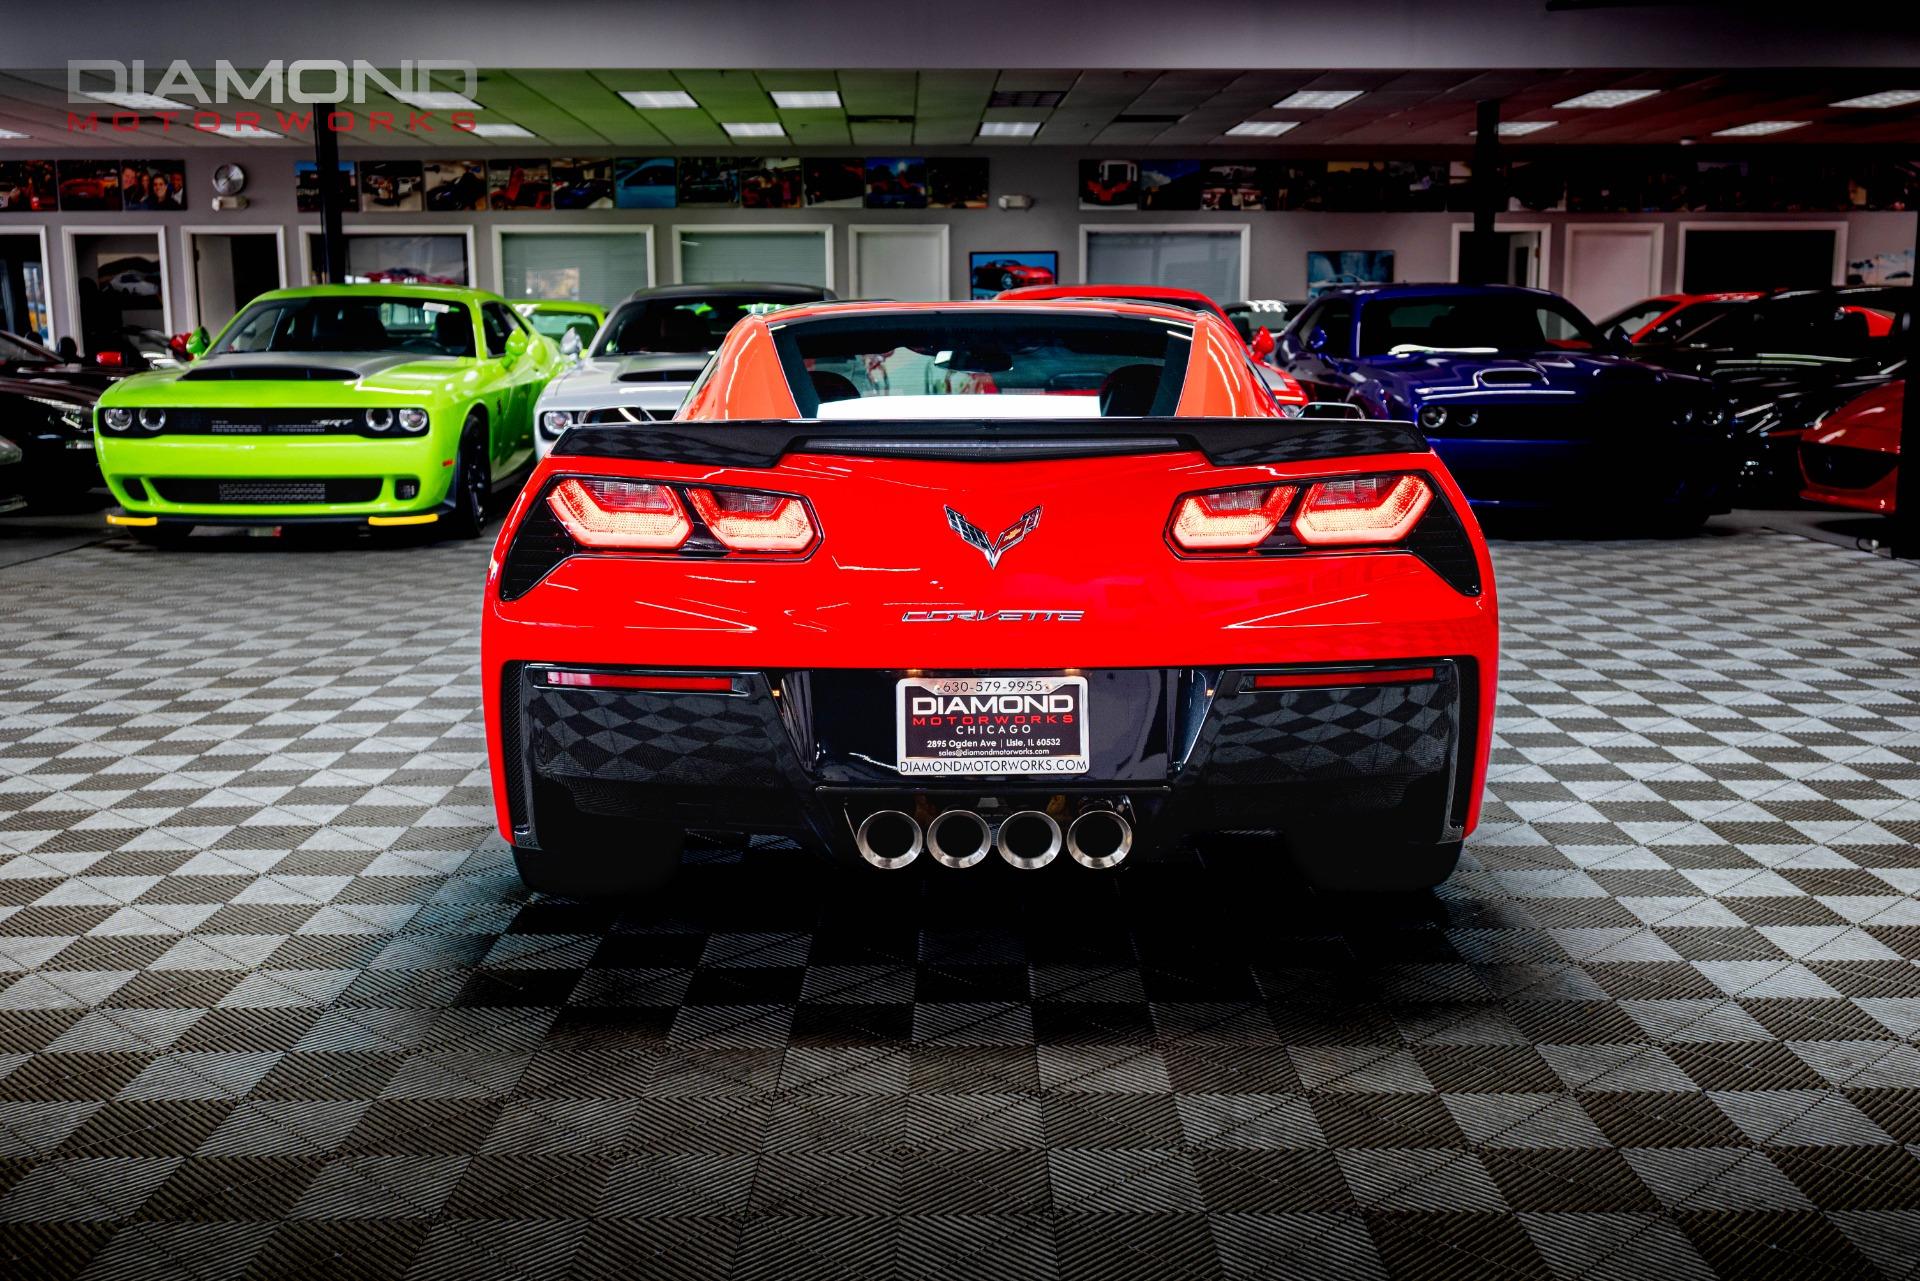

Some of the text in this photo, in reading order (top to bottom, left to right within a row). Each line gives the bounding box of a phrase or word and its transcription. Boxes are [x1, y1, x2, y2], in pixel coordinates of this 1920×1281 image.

[901, 609, 1085, 622] CORVETTE
[943, 680, 1043, 693] 630-579-9955
[912, 695, 1074, 715] DIAMOND
[912, 714, 1073, 726] MOTORWORKS
[956, 724, 1031, 735] CHICAGO
[926, 737, 1061, 749] 2895 Ogden Ave Lisle, IL 60532
[938, 748, 1050, 757] sales@diamondmotorworks.com
[900, 760, 1087, 773] DIAMONDMOTORWORKS.COM
